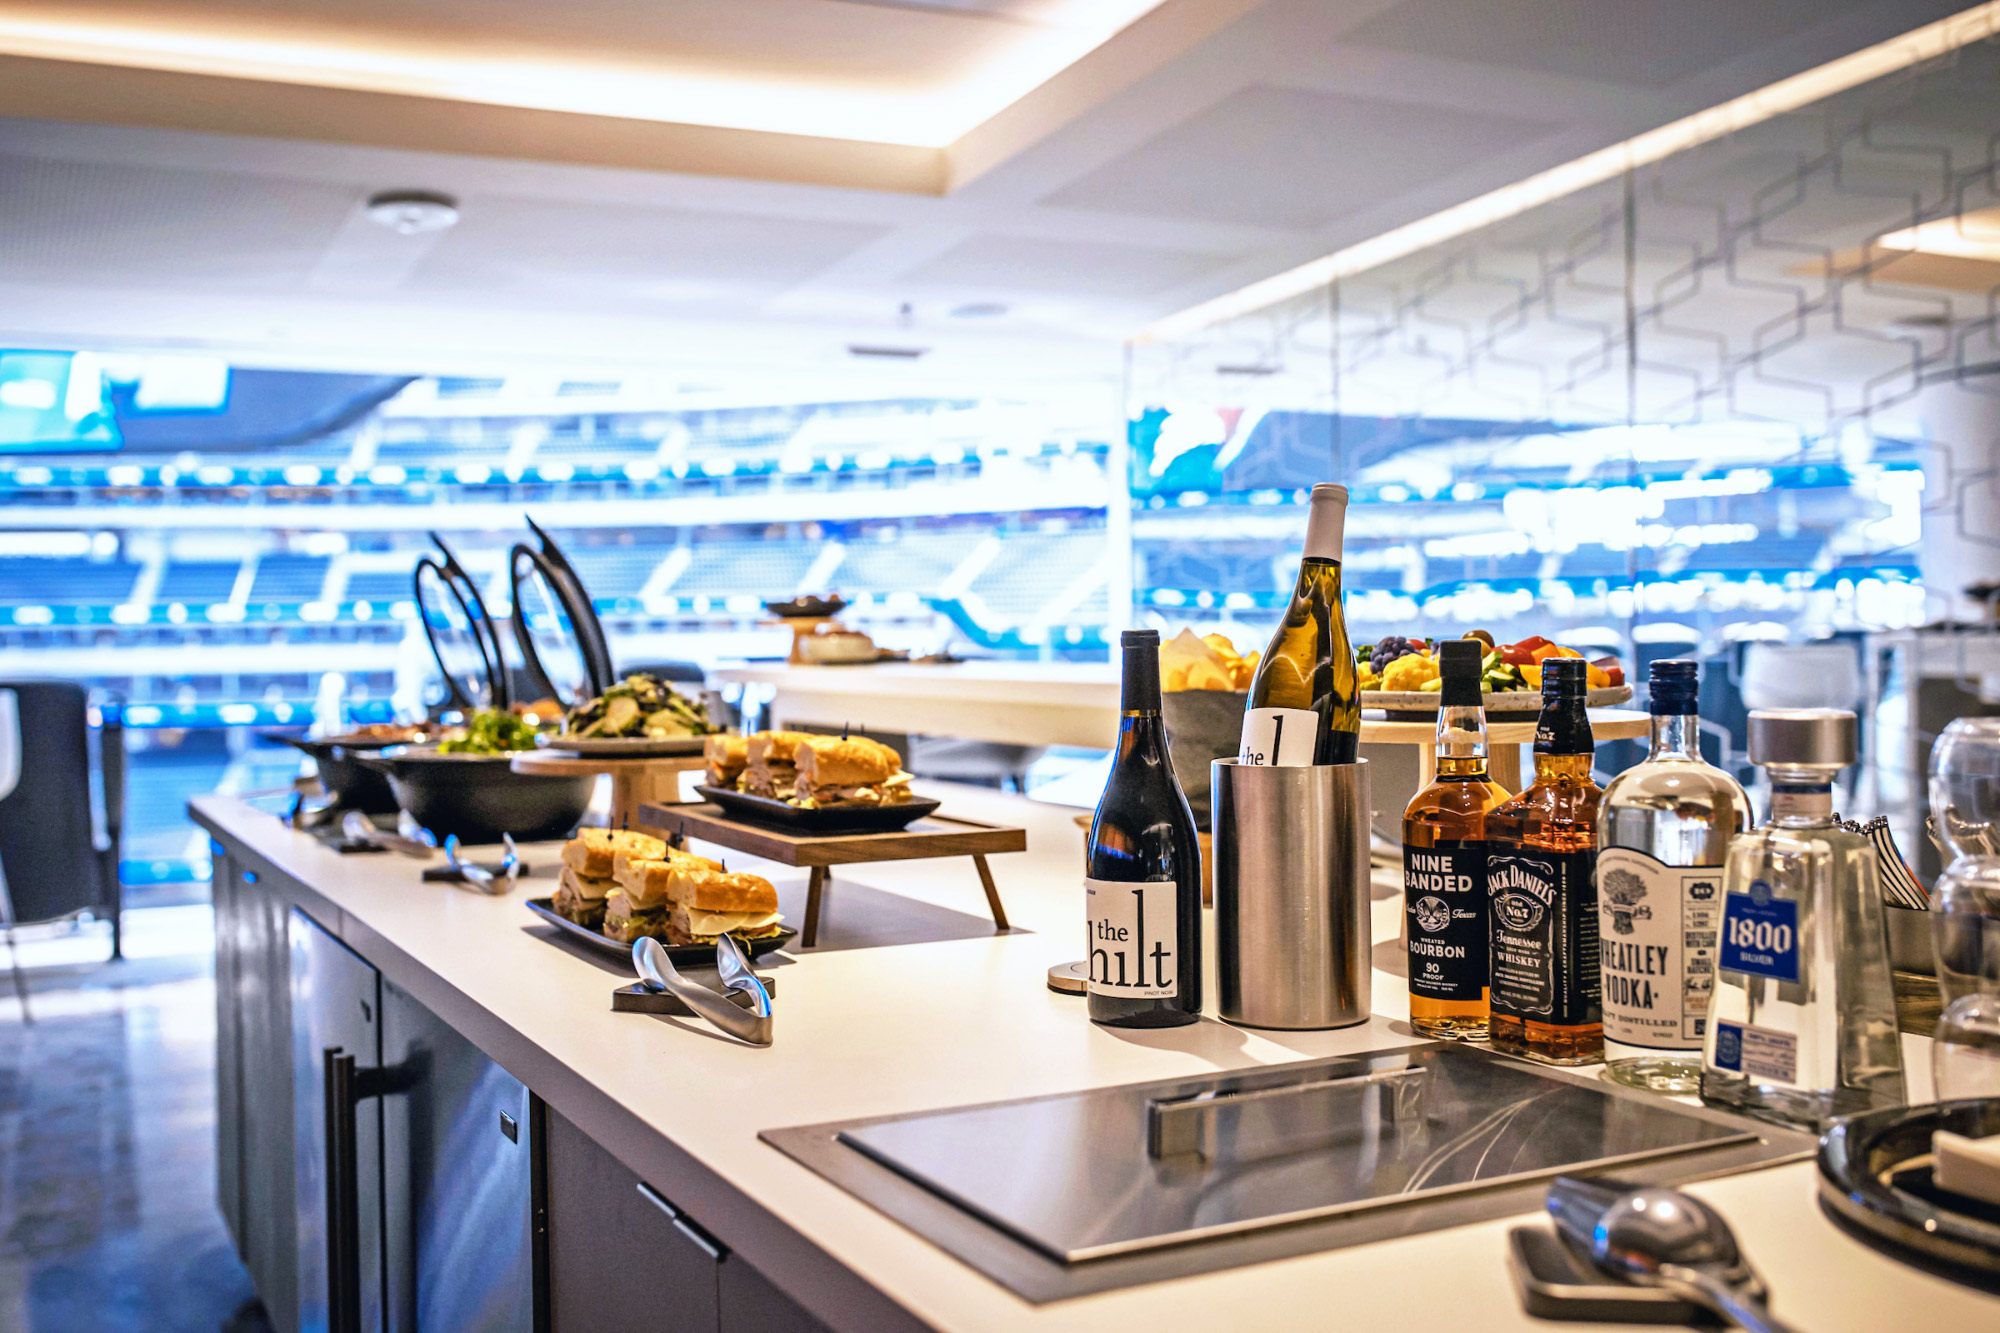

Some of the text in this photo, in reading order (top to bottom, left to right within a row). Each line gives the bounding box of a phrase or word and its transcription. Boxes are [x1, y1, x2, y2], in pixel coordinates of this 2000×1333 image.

[1412, 853, 1453, 873] NINE
[1405, 870, 1473, 892] BANDED
[1487, 870, 1511, 897] JACK
[1510, 864, 1558, 908] DANIEL'S
[1087, 889, 1173, 988] hilt
[1098, 919, 1128, 941] the
[1496, 929, 1542, 950] Tennessee
[1728, 916, 1792, 954] 1800
[1410, 940, 1465, 958] BOURBON
[1426, 962, 1440, 974] 90
[1497, 952, 1541, 969] WHISKEY
[1422, 972, 1445, 981] PROOF
[1606, 973, 1653, 1010] VODKA
